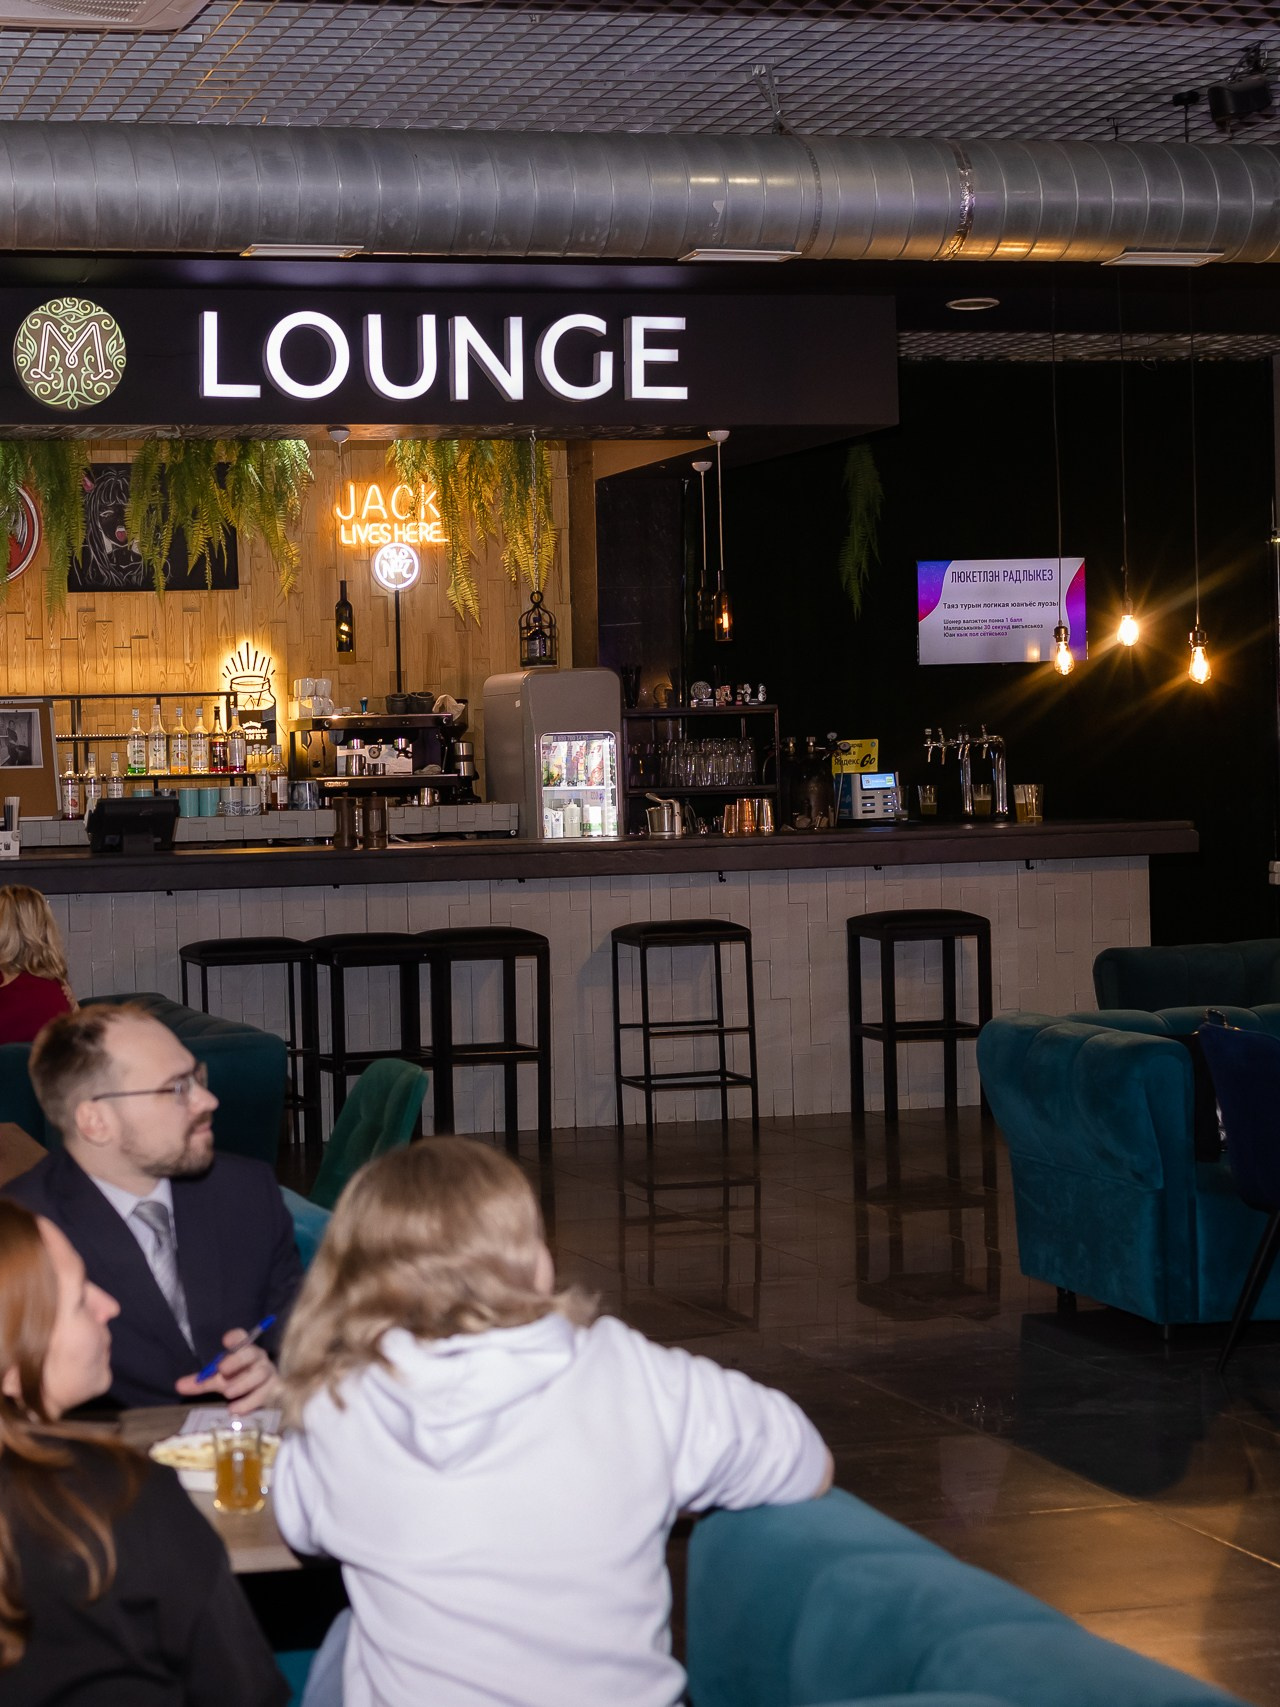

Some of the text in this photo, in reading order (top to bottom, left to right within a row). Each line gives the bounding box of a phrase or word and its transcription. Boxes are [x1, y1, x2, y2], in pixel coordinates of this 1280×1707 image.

[199, 310, 688, 401] LOUNGE
[335, 484, 441, 520] JACK
[340, 522, 449, 545] LIVES HERE
[951, 569, 1053, 584] ЛЮКЕТЛЭН РАДЛЫКЕЗ
[860, 753, 876, 767] Go
